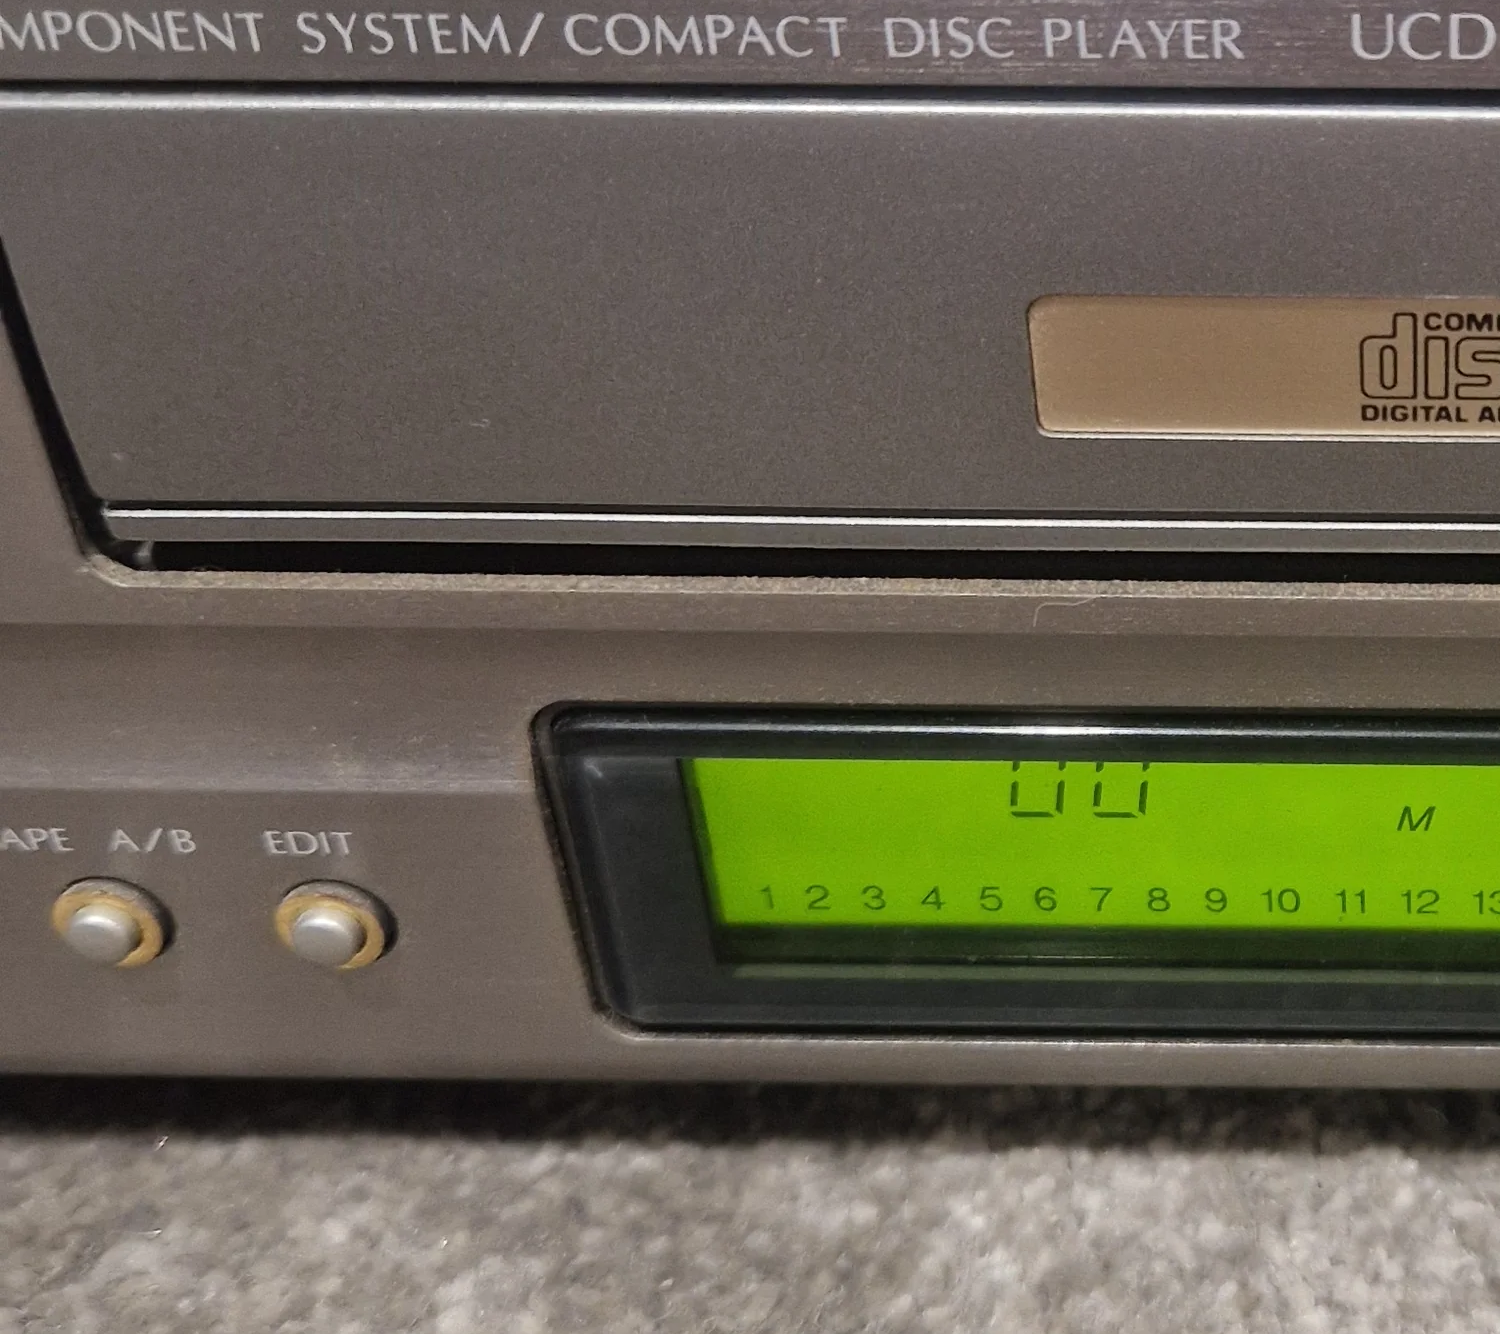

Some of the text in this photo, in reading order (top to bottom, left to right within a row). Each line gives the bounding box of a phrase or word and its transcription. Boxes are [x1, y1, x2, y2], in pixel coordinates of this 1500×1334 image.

[883, 16, 1014, 59] DISC
[1043, 17, 1245, 60] PLAYER
[1360, 405, 1468, 423] DIGITAL
[1396, 805, 1436, 833] M
[108, 827, 197, 855] A/B
[261, 830, 353, 856] EDIT
[759, 885, 775, 910] 1
[804, 884, 831, 911] 2
[861, 885, 887, 912] 3
[920, 886, 946, 911] 4
[979, 886, 1004, 912] 5
[1033, 886, 1058, 912] 6
[1089, 887, 1114, 912] 7
[1146, 886, 1172, 913] 8
[1204, 887, 1229, 914] 9
[1261, 887, 1301, 914] 10
[1335, 889, 1367, 914] 11
[1401, 888, 1440, 915] 12
